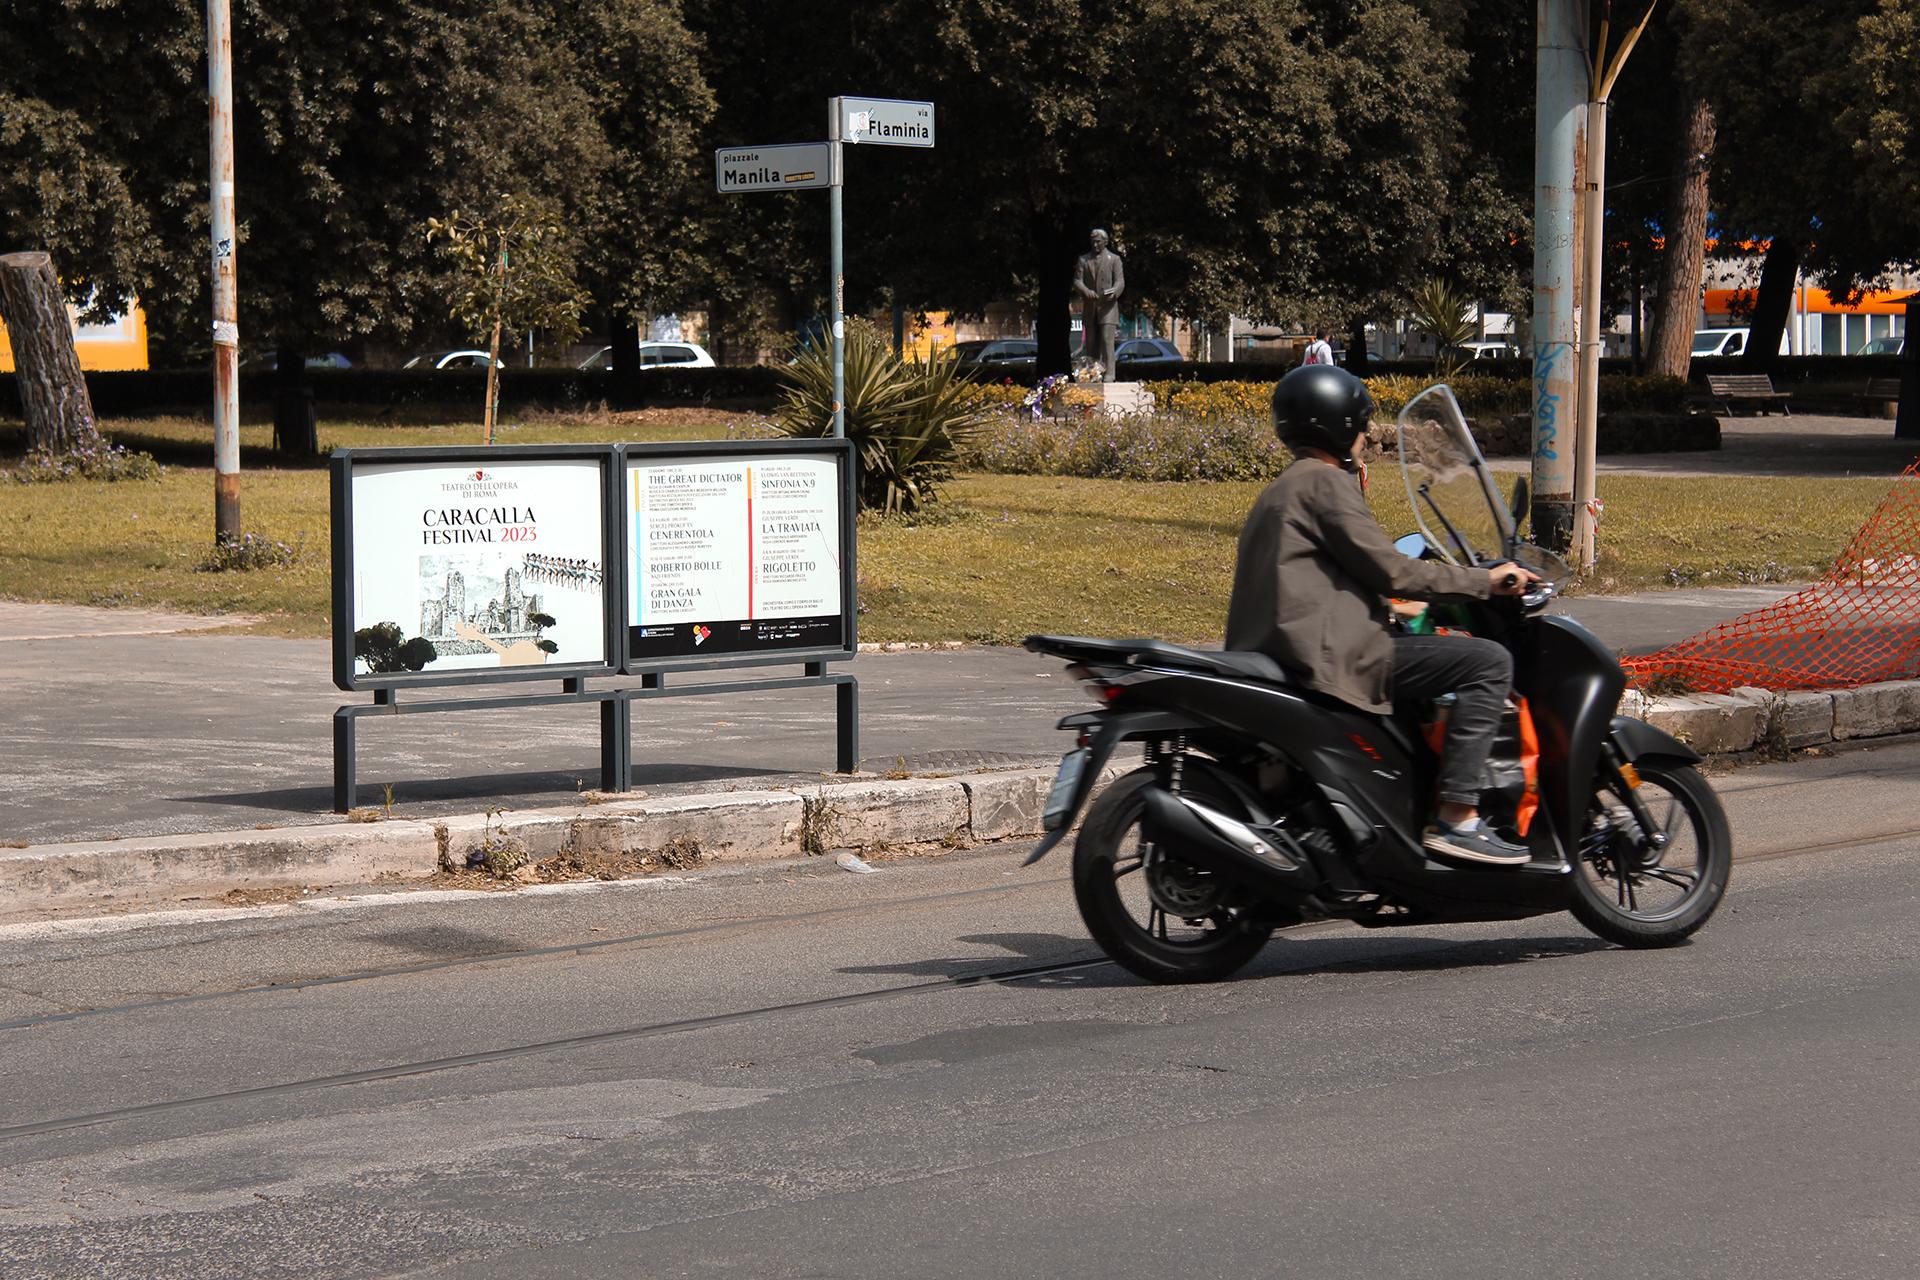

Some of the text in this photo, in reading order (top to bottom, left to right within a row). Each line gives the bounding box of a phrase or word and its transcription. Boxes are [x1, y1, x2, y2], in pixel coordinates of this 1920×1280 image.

[918, 108, 928, 117] via
[869, 120, 929, 139] Flaminia
[723, 153, 759, 164] piazzale
[724, 168, 780, 185] Manila
[648, 473, 743, 485] THE GREAT DICTATOR
[761, 479, 801, 489] SINFONIA
[442, 483, 472, 491] TEATRO
[462, 490, 498, 499] DI ROMA
[423, 507, 536, 527] CARACALLA
[762, 522, 821, 534] LA TRAVIATA
[423, 526, 537, 545] FESTIVAL 2023
[650, 529, 714, 541] CENERENTOLA
[650, 561, 722, 572] ROBERTO BOLLE
[763, 561, 816, 573] RIGOLETTO
[650, 587, 702, 599] GRAN GALA
[651, 598, 693, 609] DI DANZA
